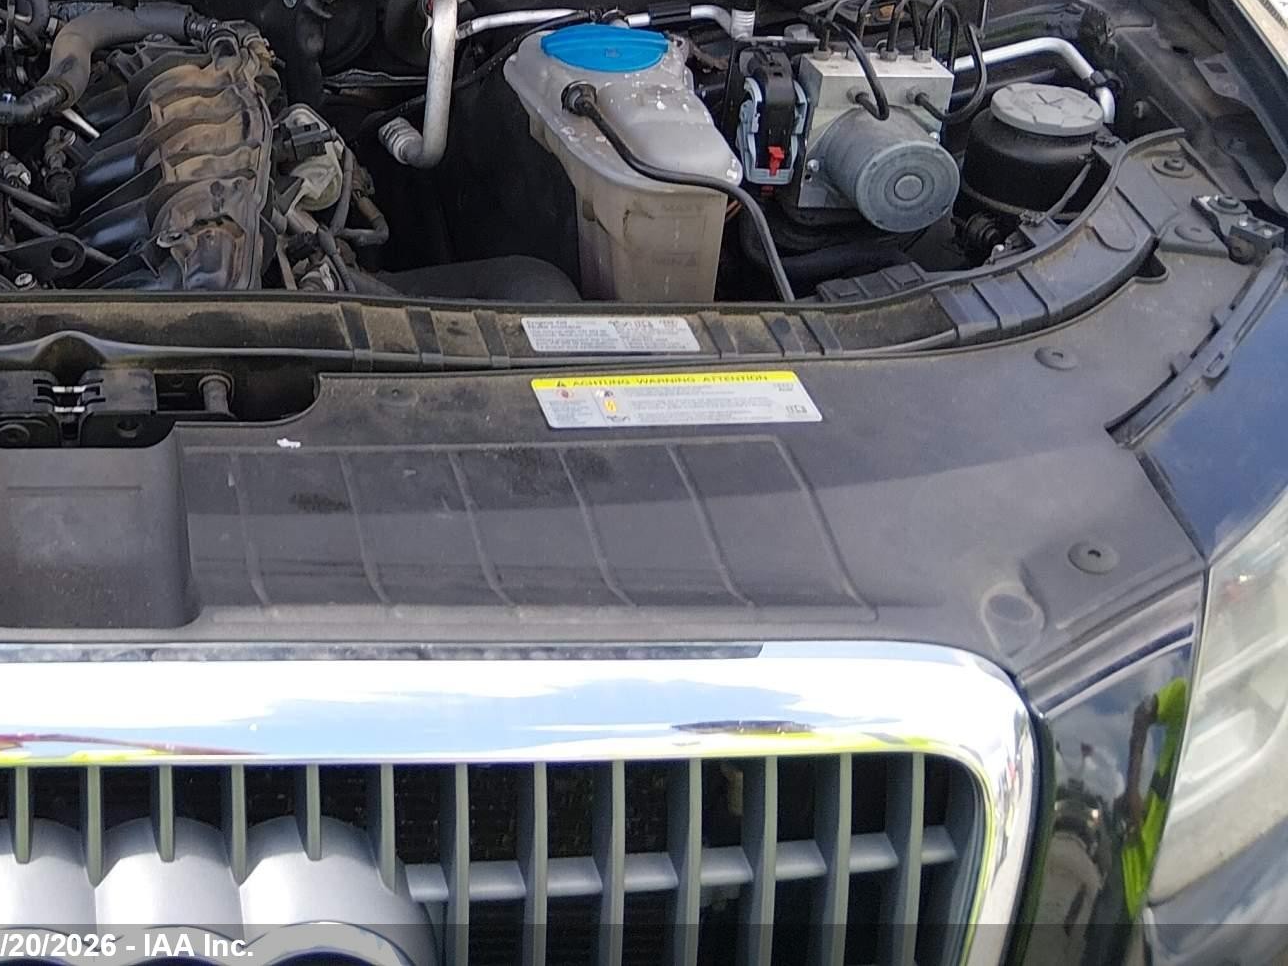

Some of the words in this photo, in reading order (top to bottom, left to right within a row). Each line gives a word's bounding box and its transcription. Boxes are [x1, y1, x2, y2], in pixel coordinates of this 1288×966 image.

[572, 379, 631, 387] ACHTUNG
[635, 376, 696, 385] WARNING
[703, 374, 769, 383] ATTENTION
